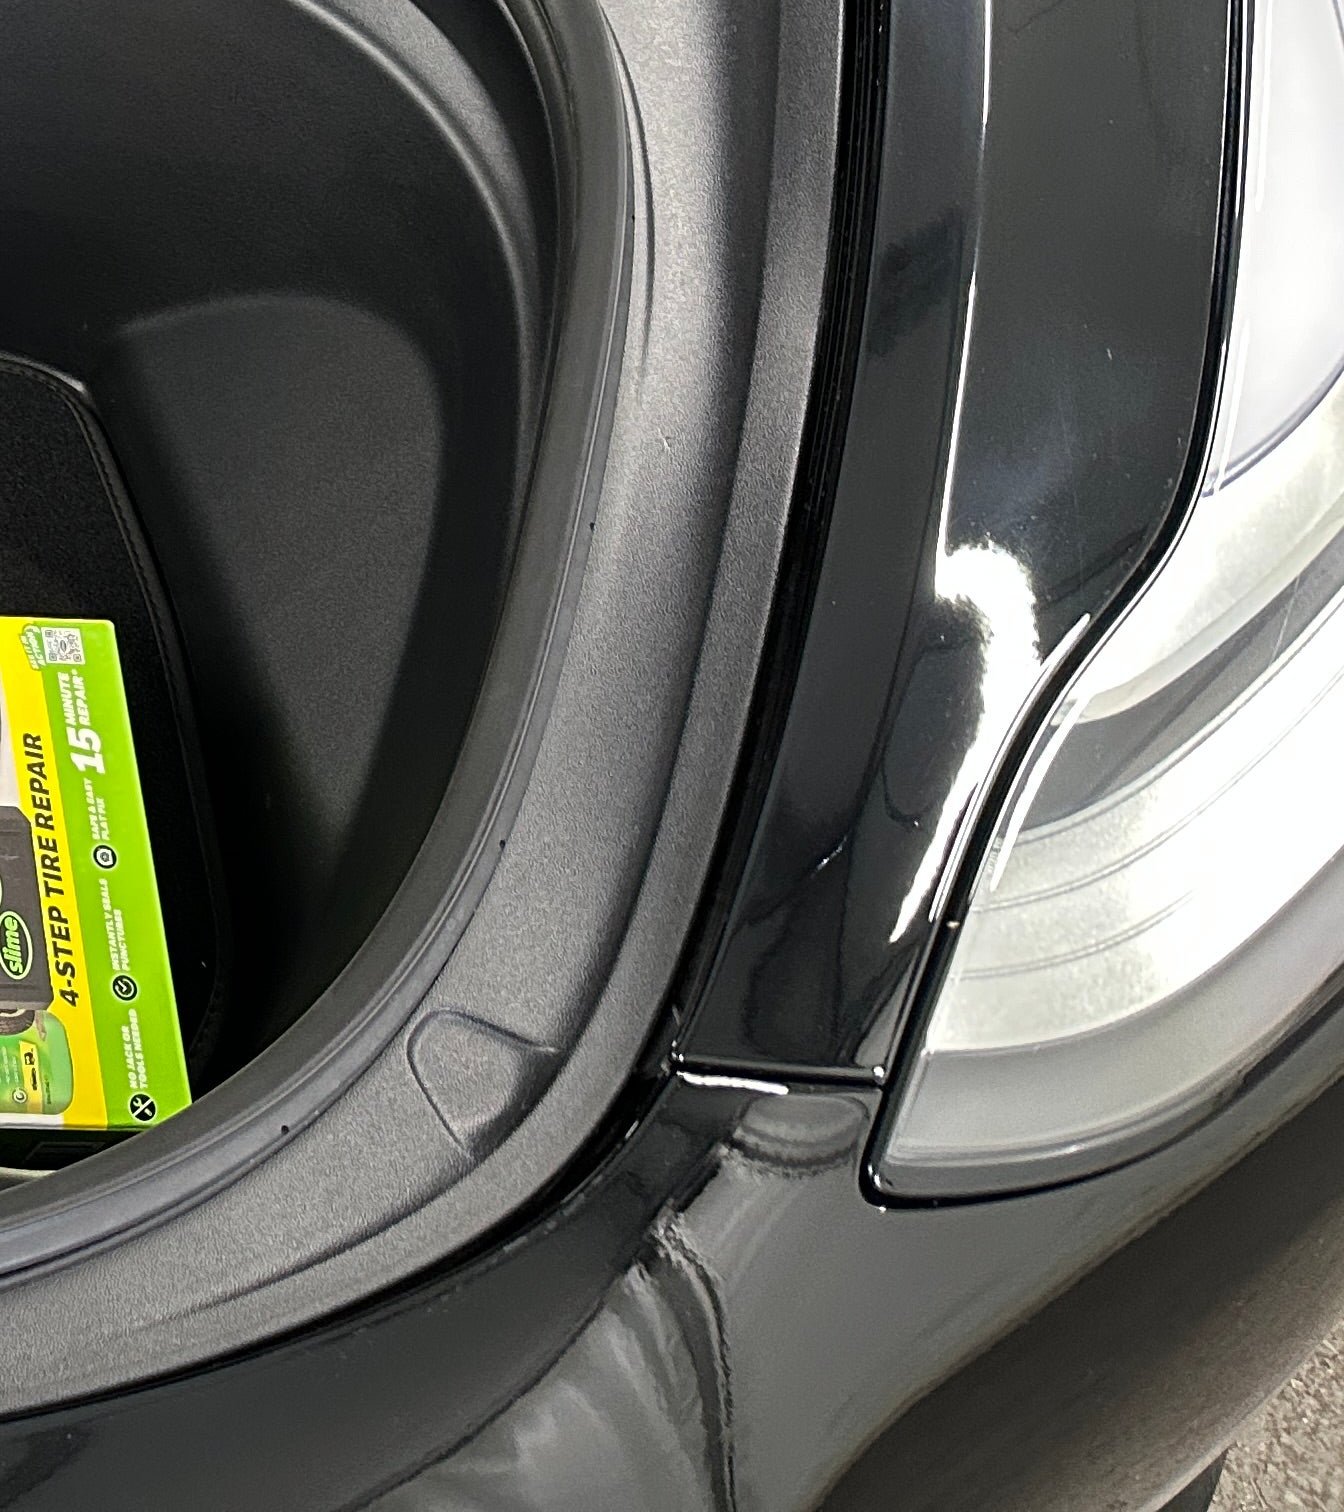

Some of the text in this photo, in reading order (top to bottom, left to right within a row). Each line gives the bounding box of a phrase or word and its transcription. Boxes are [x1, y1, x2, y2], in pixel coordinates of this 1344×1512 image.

[57, 671, 77, 726] MINUTE
[66, 727, 106, 775] 15
[22, 732, 77, 1007] 4-STEP TIRE REPAIR
[2, 916, 23, 974] slime
[105, 912, 120, 971] INSTANTLY
[114, 909, 130, 971] PUNCTURES
[121, 1025, 138, 1089] NO JACK OR
[128, 1008, 148, 1089] TOOLS NEEDED
